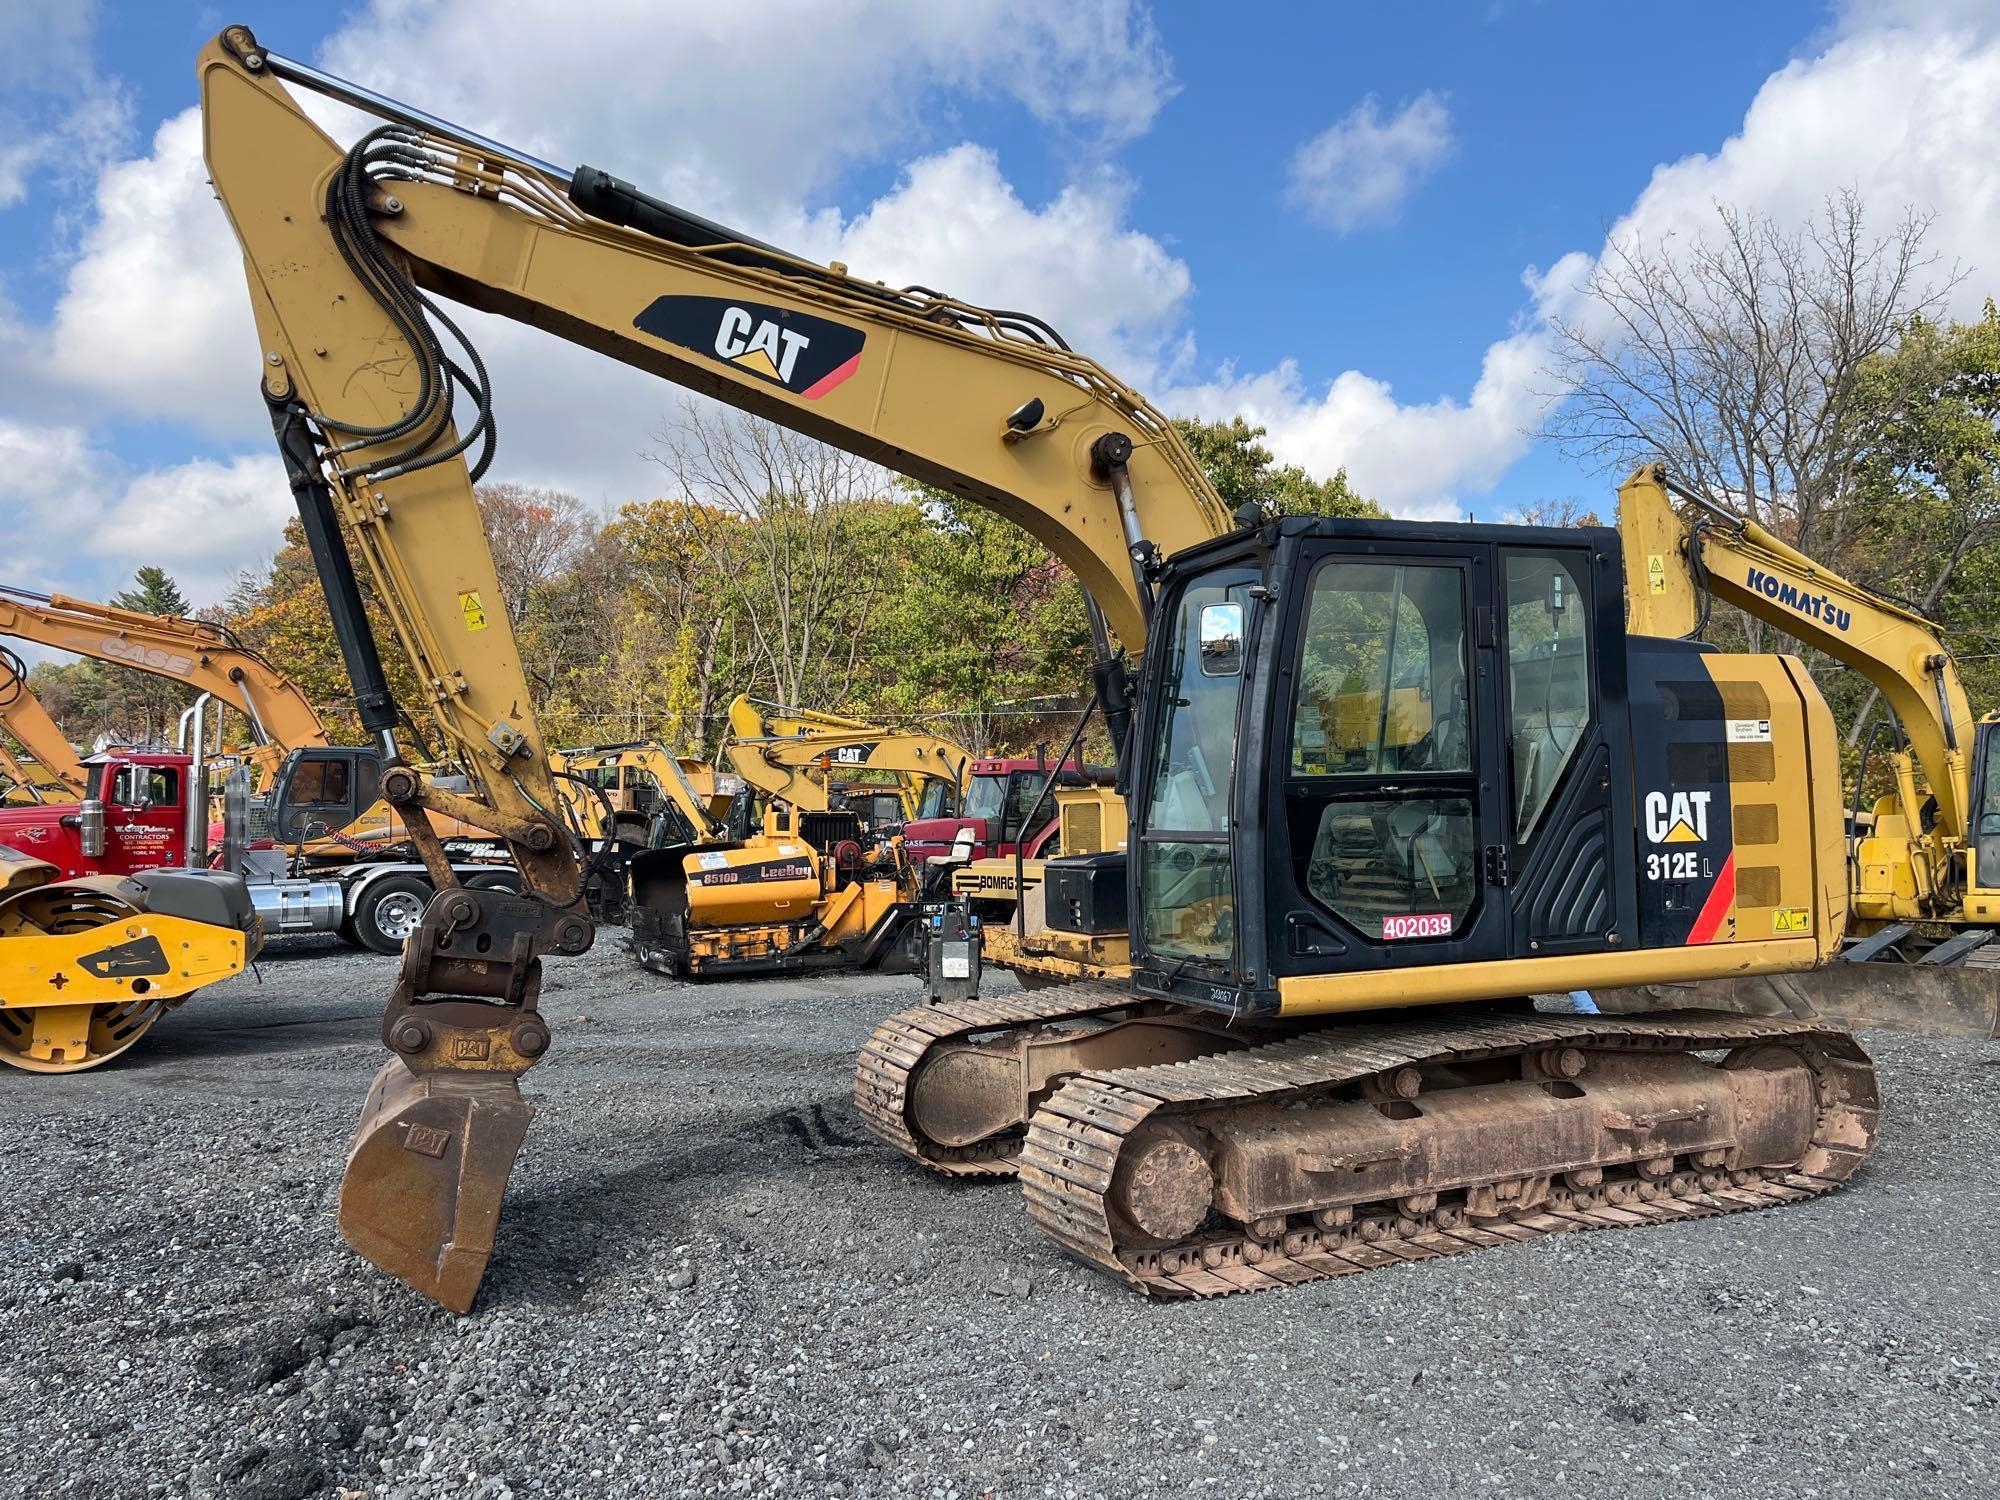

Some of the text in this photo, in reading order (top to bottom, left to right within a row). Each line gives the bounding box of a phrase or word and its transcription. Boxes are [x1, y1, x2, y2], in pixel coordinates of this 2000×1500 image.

[715, 306, 810, 384] CAT
[1746, 567, 1851, 632] KOMATSU
[101, 636, 195, 677] CASE
[605, 757, 617, 766] CAT
[838, 747, 861, 763] CAT
[209, 759, 235, 771] ASE
[1645, 791, 1711, 843] CAT
[444, 842, 496, 854] Eager
[761, 864, 812, 880] LeeBoy
[1646, 852, 1713, 880] 312E L
[704, 873, 738, 884] 8510D
[980, 875, 1014, 890] BOMAG
[1384, 916, 1452, 937] 402039
